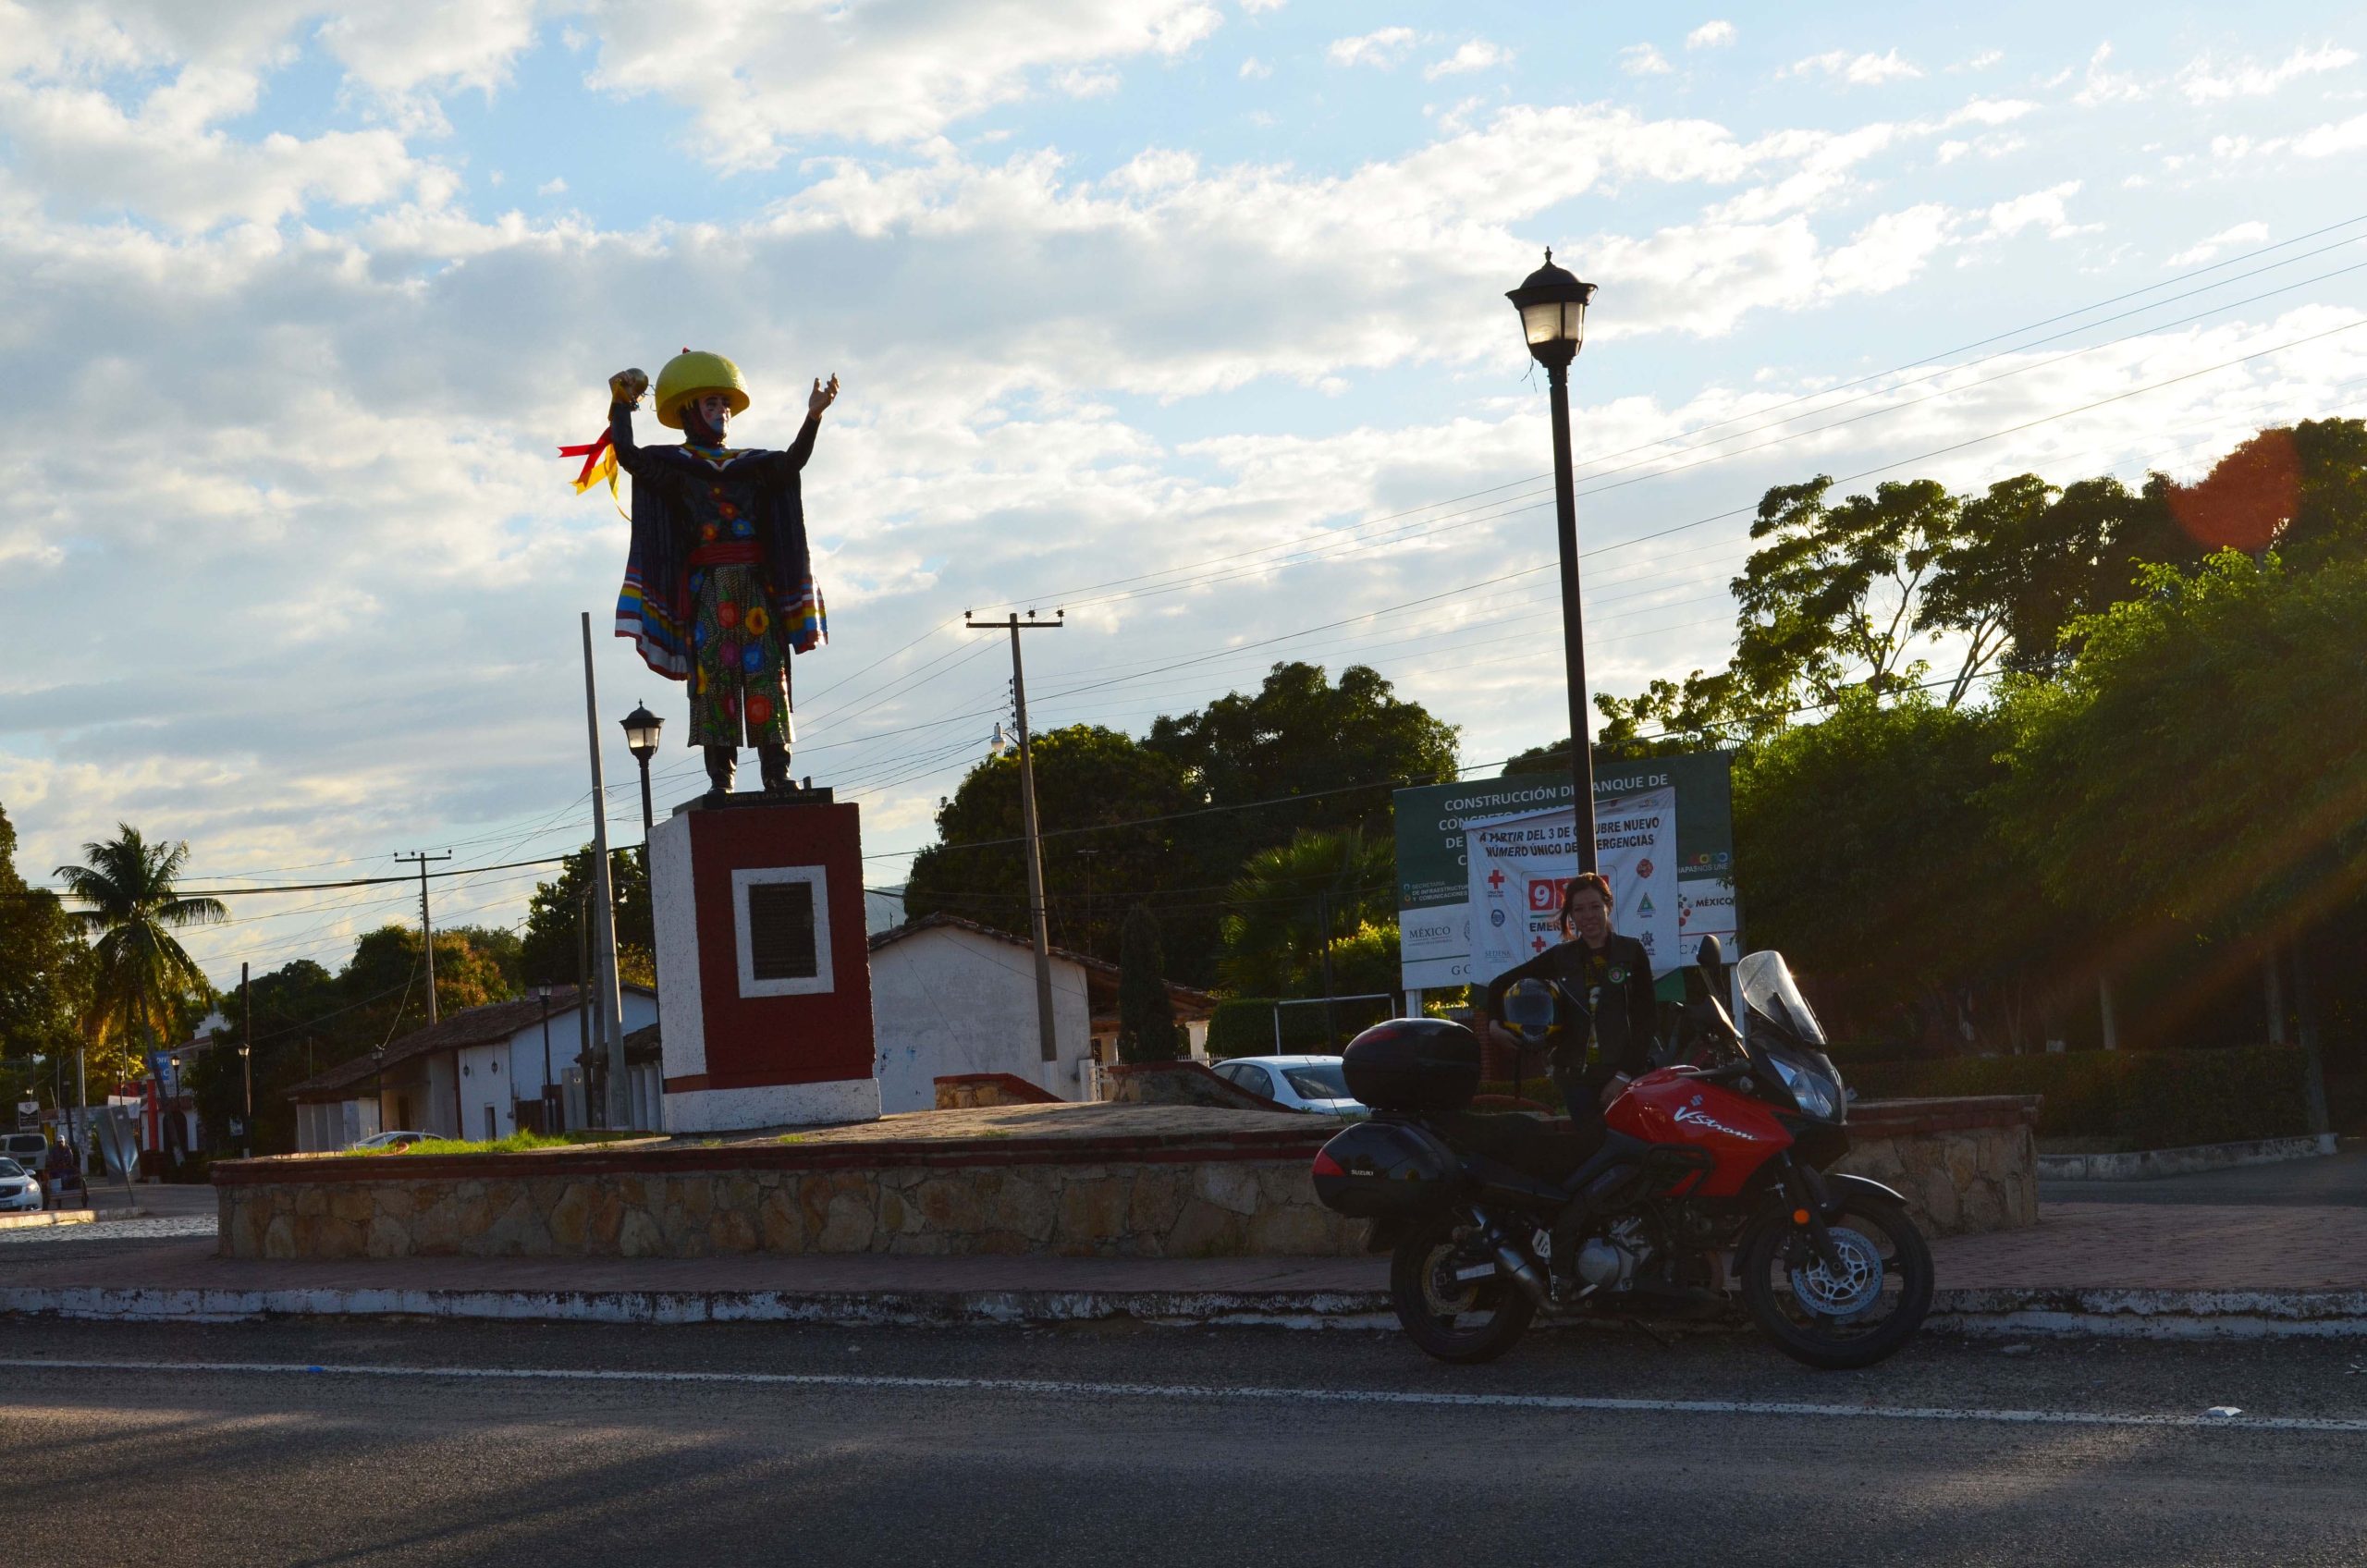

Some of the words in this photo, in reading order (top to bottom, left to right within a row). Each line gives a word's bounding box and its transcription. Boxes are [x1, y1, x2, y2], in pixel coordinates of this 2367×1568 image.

[1444, 786, 1556, 812] CONSTRUCCIÓN
[1593, 776, 1643, 792] ANQUE
[1649, 773, 1668, 787] DE
[1479, 833, 1487, 843] A
[1490, 831, 1524, 843] PARTIR
[1527, 828, 1545, 841] DEL
[1548, 827, 1554, 839] 3
[1557, 826, 1571, 838] DE
[1624, 816, 1660, 831] NUEVO
[1486, 842, 1527, 857] NÚMERO
[1530, 842, 1562, 855] ÚNICO
[1564, 843, 1577, 852] DE
[1598, 834, 1654, 851] ERGENCIAS
[1419, 890, 1468, 901] COMUNICACIONES
[1696, 896, 1732, 908] MÉXICO
[1409, 925, 1451, 938] MÉXICO
[1350, 1169, 1374, 1177] SUZUKI
